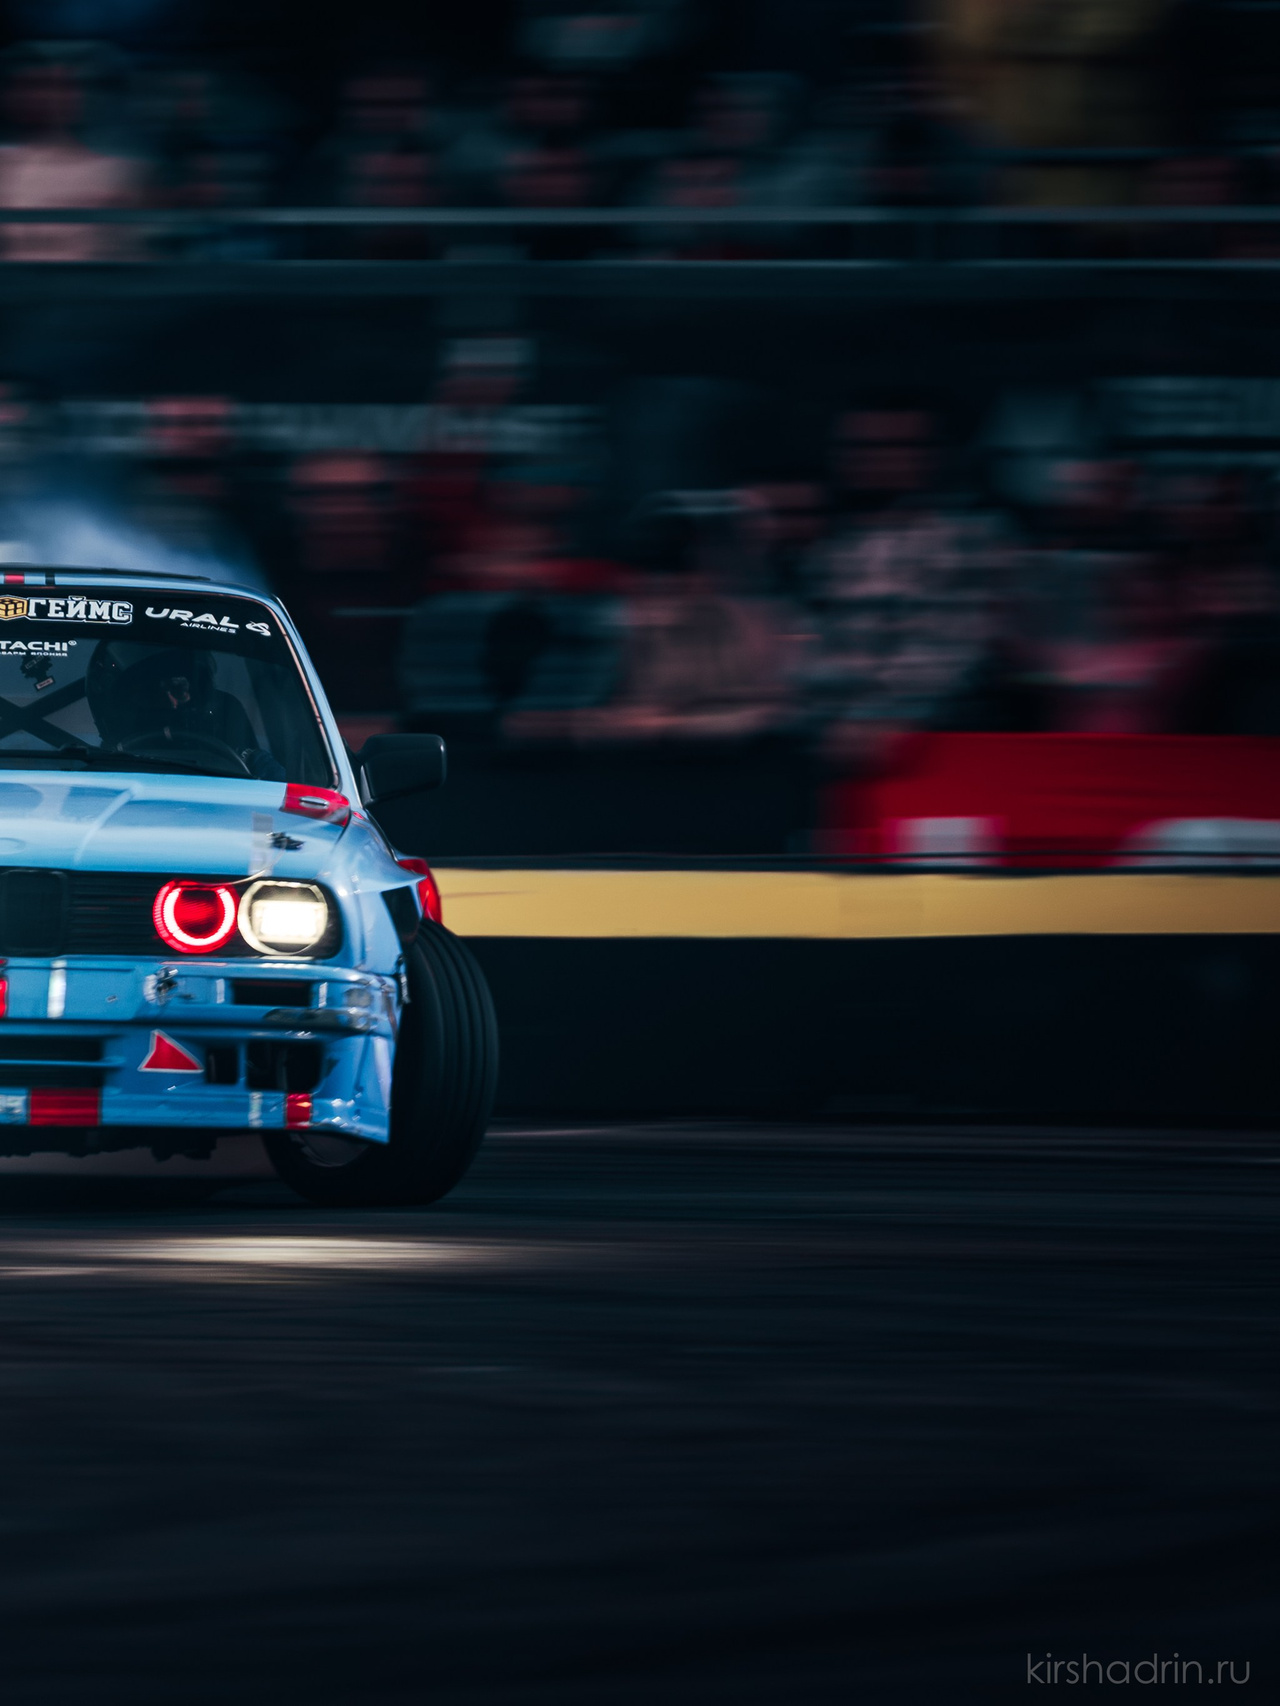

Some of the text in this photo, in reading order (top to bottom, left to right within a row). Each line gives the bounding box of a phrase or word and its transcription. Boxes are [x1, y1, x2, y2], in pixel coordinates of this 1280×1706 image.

[28, 596, 133, 624] ГЕЙМС
[145, 606, 240, 629] URAL
[180, 621, 237, 635] AIRLINES
